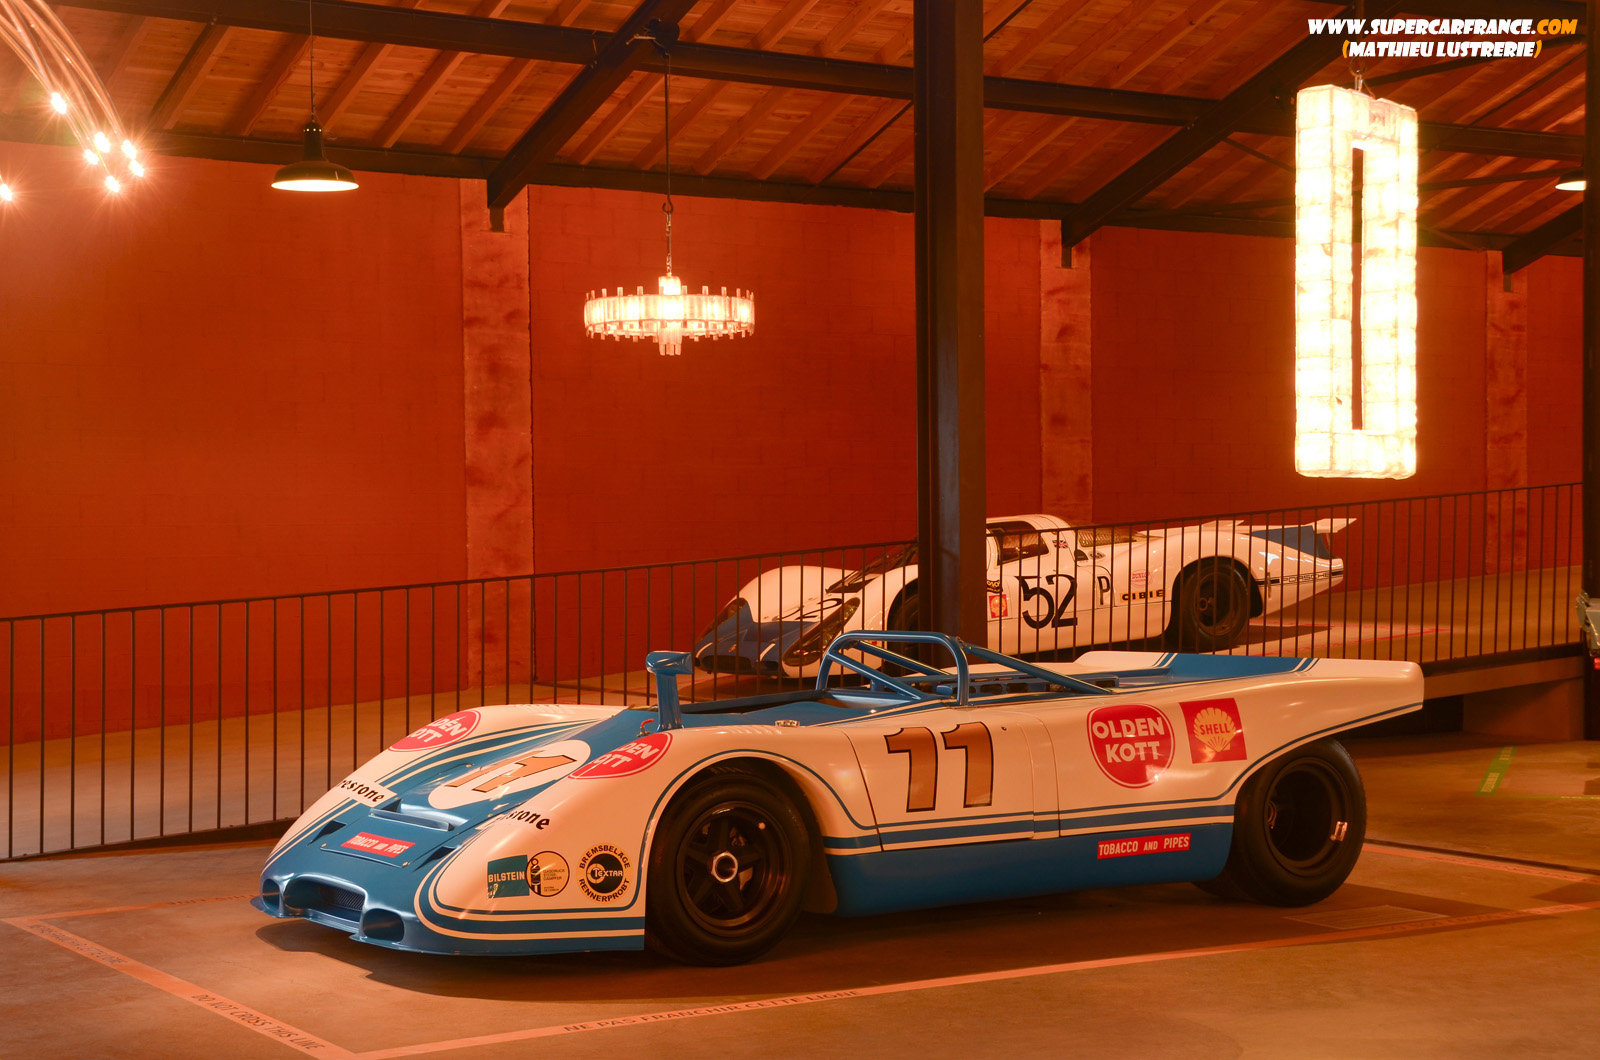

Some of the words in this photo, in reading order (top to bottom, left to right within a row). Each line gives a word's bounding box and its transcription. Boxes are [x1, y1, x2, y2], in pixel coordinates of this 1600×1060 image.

[1014, 575, 1077, 628] 52
[428, 718, 467, 736] DEN
[1092, 717, 1164, 739] OLDEN
[1199, 722, 1230, 735] SHELL
[615, 742, 659, 759] DEN
[1105, 741, 1160, 763] KOTT
[884, 721, 993, 813] 11
[1099, 841, 1138, 856] TOBACCO
[1143, 841, 1158, 851] AND
[1163, 836, 1190, 849] PIPES
[488, 870, 525, 883] BILSTEIN
[578, 878, 630, 902] RENNERPROBT
[639, 1005, 740, 1022] FRANCHIR
[804, 990, 859, 1002] LIGNE
[229, 1011, 272, 1026] CROSS
